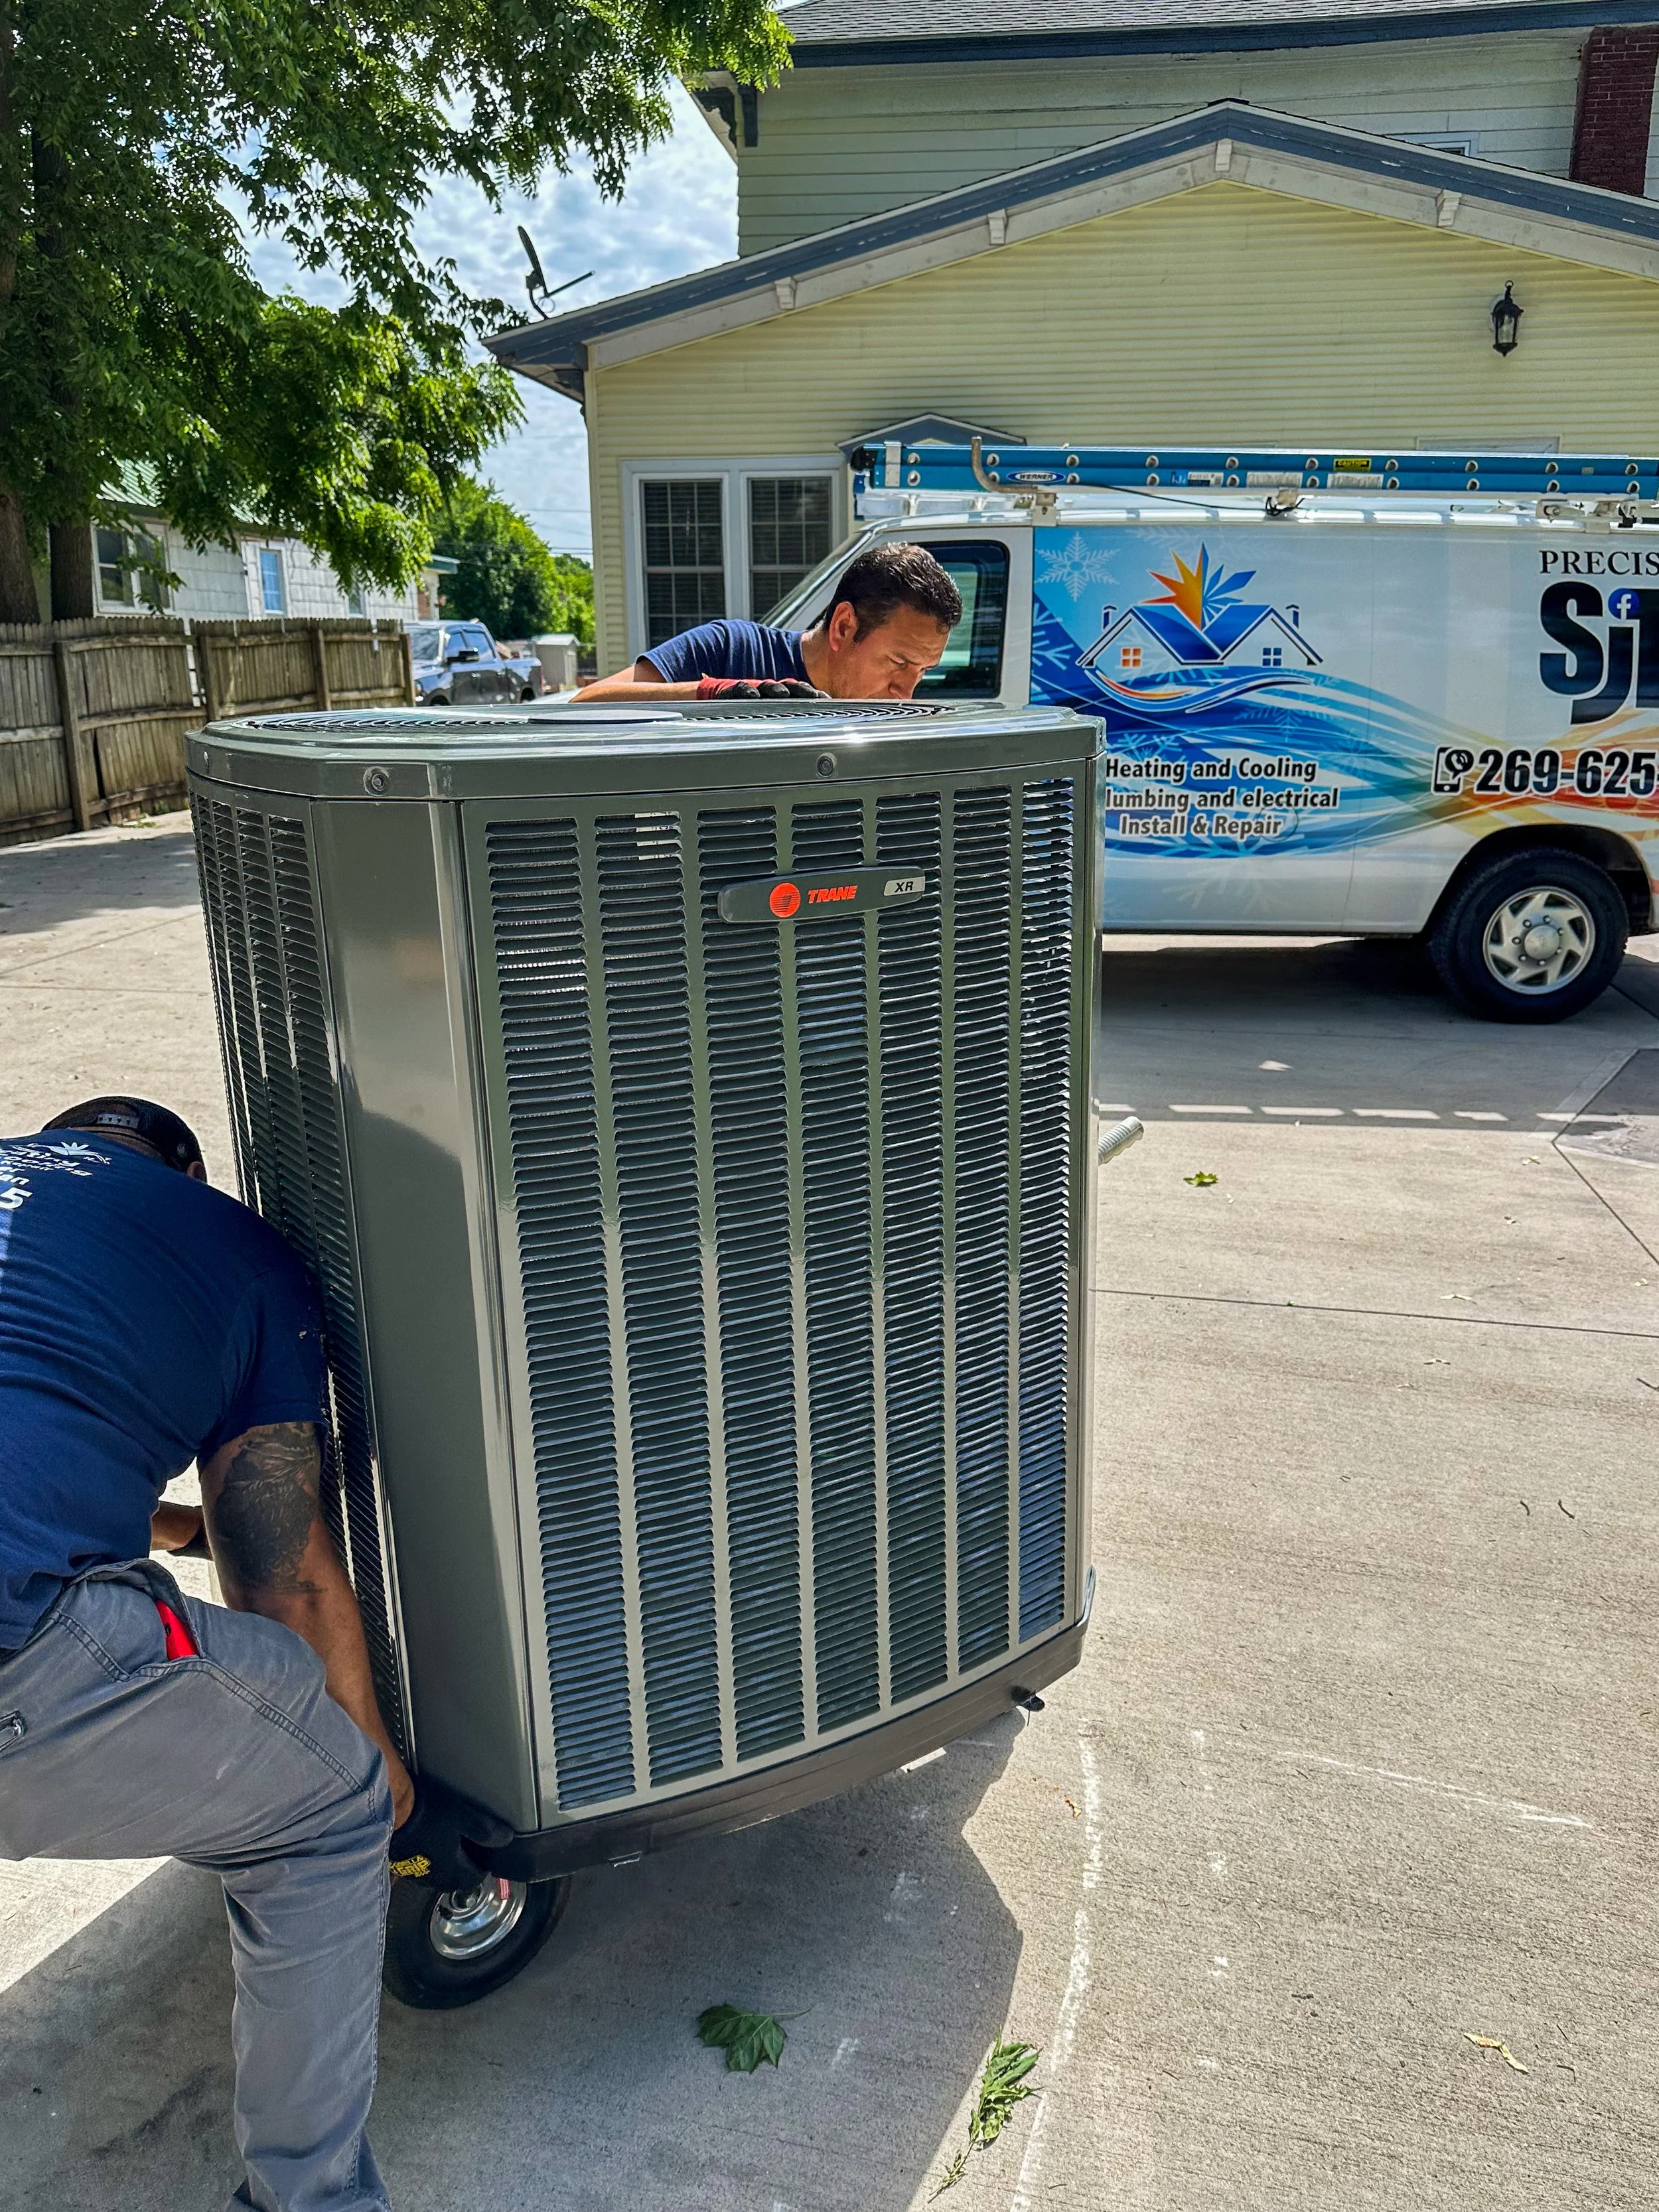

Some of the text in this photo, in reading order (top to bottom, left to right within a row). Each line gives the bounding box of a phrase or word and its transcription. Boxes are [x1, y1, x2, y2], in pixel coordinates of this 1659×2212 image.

[1539, 551, 1659, 576] PRECIS
[1106, 758, 1316, 782] Heating and Cooling
[1476, 749, 1659, 795] 269-625
[1106, 788, 1338, 812] lumbing and electrical
[1121, 816, 1281, 839] Install & Repair
[808, 886, 857, 904] TRANE
[895, 881, 914, 892] XR
